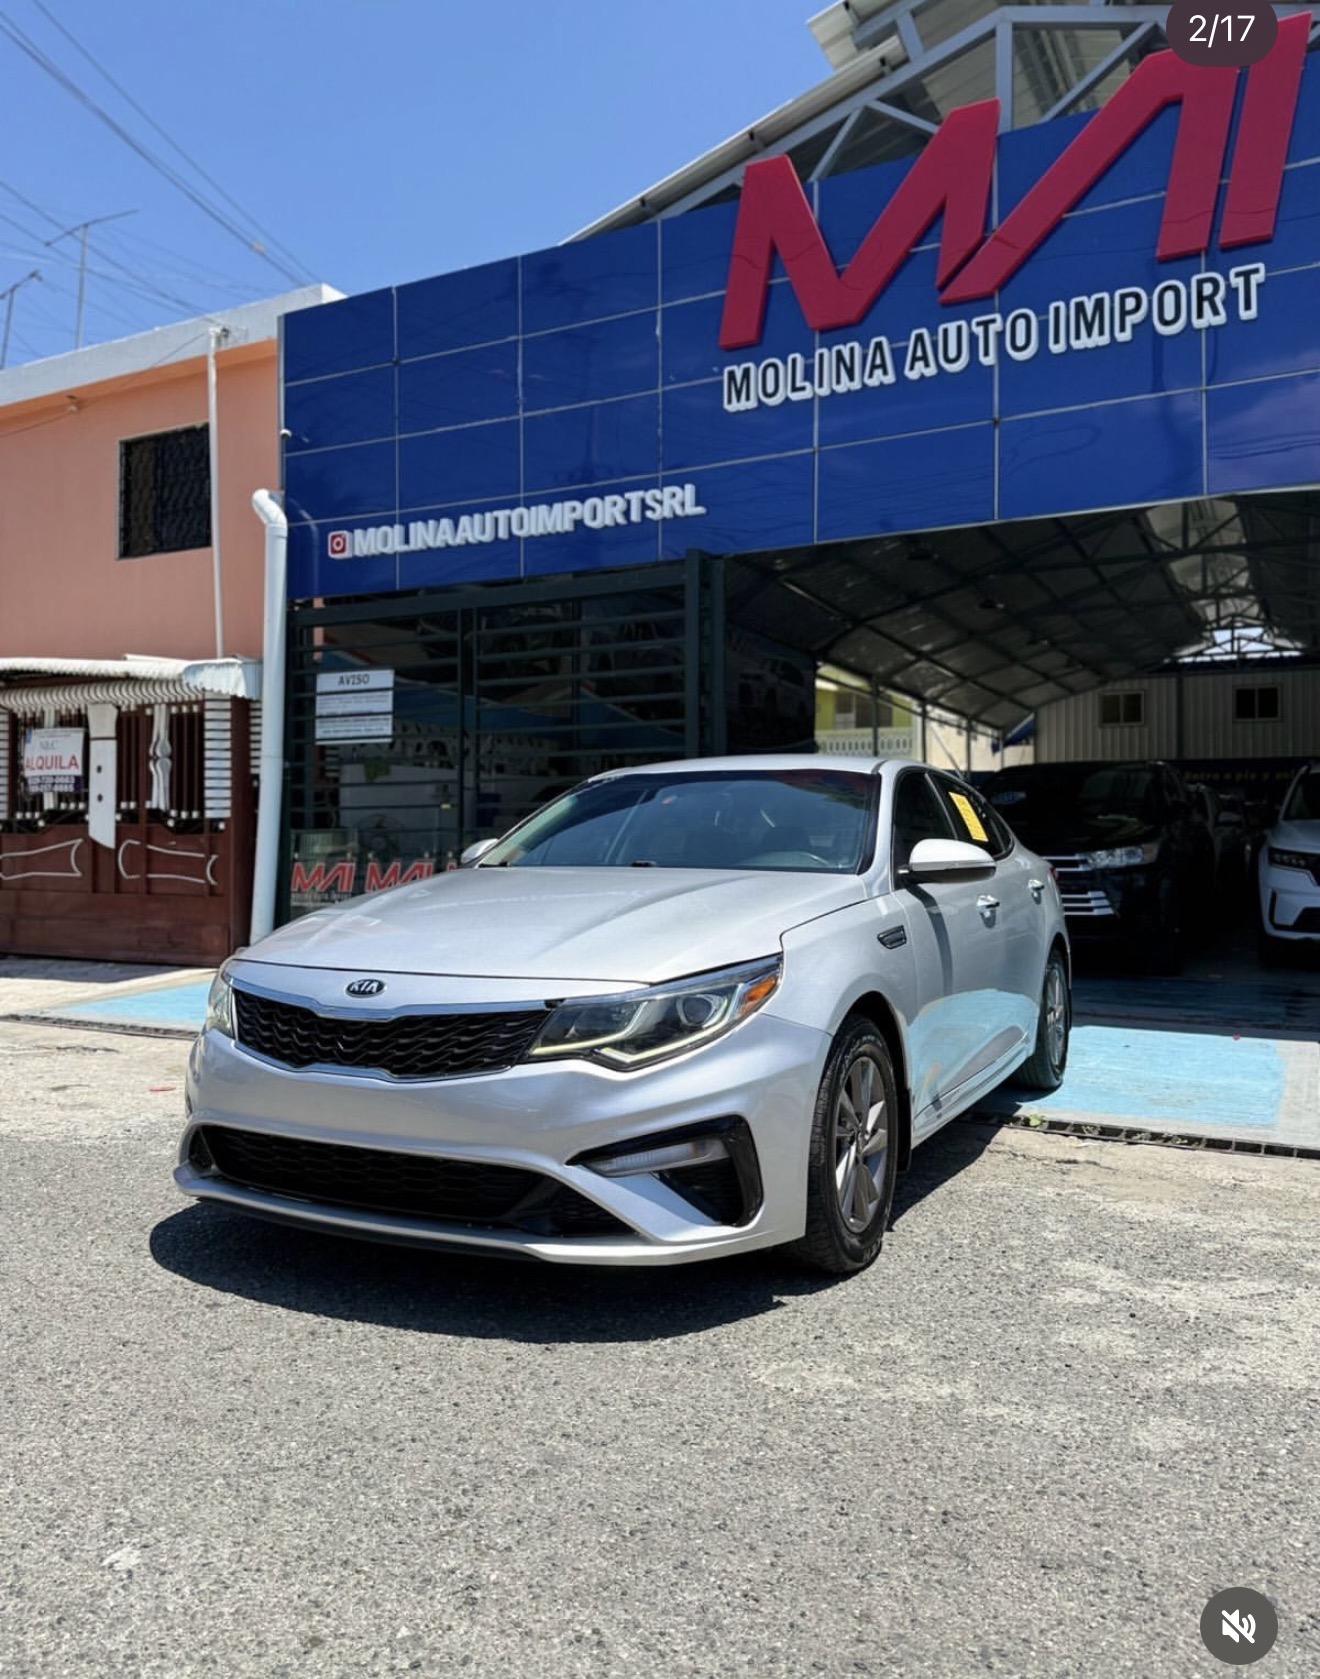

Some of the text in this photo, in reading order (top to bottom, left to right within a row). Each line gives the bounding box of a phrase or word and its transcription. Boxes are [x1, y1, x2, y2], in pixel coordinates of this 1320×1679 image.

[718, 10, 1312, 351] MAI
[723, 263, 1265, 412] MOLINA AUTO IMPORT
[350, 483, 707, 558] MOLINAAUTOIMPORTSRL
[338, 673, 370, 686] AVISO
[291, 862, 355, 893] MAI
[349, 980, 379, 993] KIA
